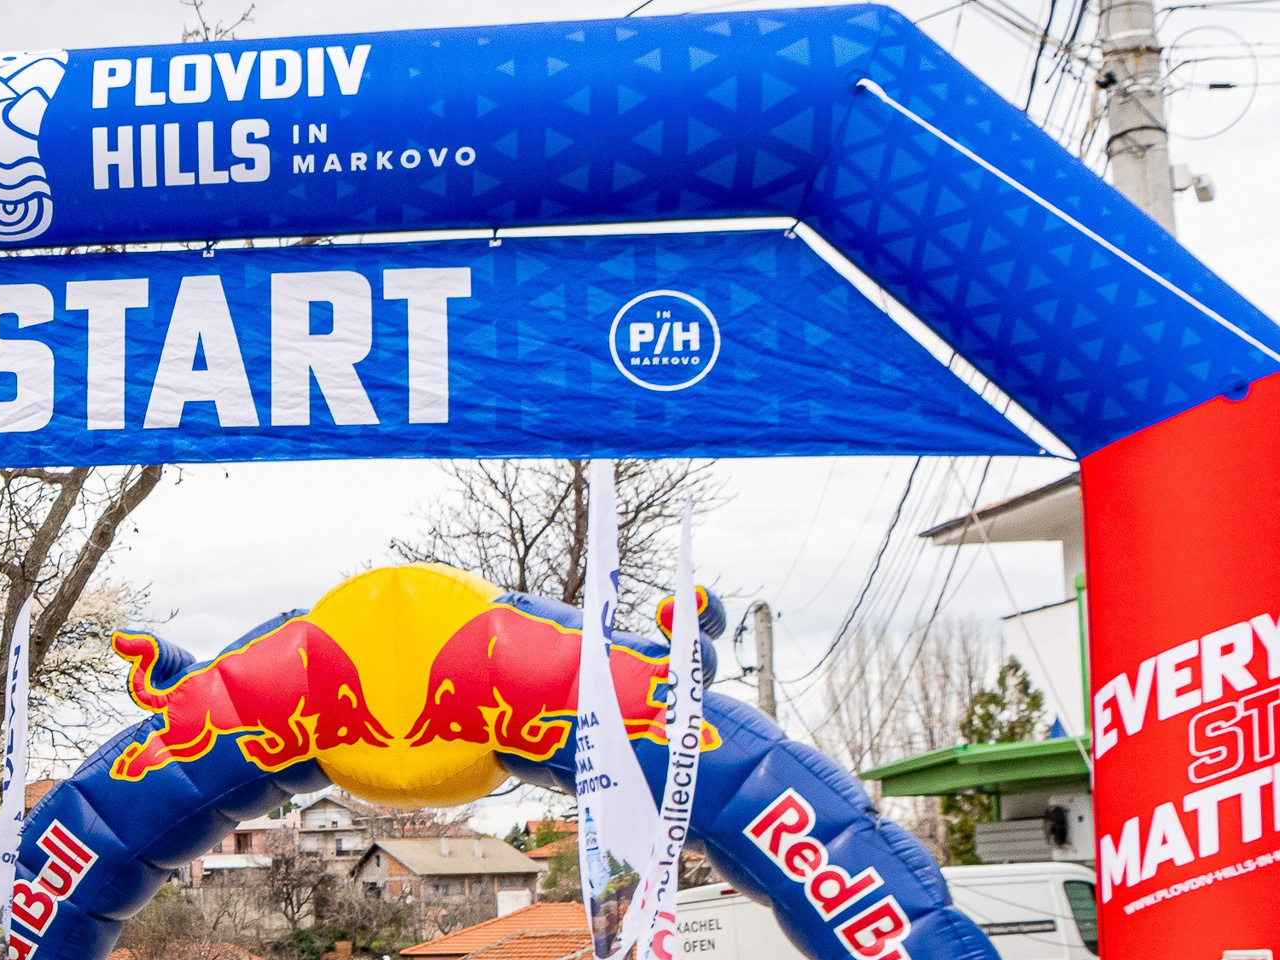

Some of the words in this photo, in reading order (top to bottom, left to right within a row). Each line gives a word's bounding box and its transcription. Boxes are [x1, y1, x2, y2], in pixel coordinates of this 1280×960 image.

[91, 44, 372, 109] PLOVDIV
[93, 118, 271, 190] HILLS
[292, 123, 328, 144] IN
[292, 146, 477, 174] MARKOVO
[656, 310, 671, 319] IN
[630, 356, 700, 366] MARKOVO
[747, 791, 879, 917] Red
[11, 822, 96, 934] Bull
